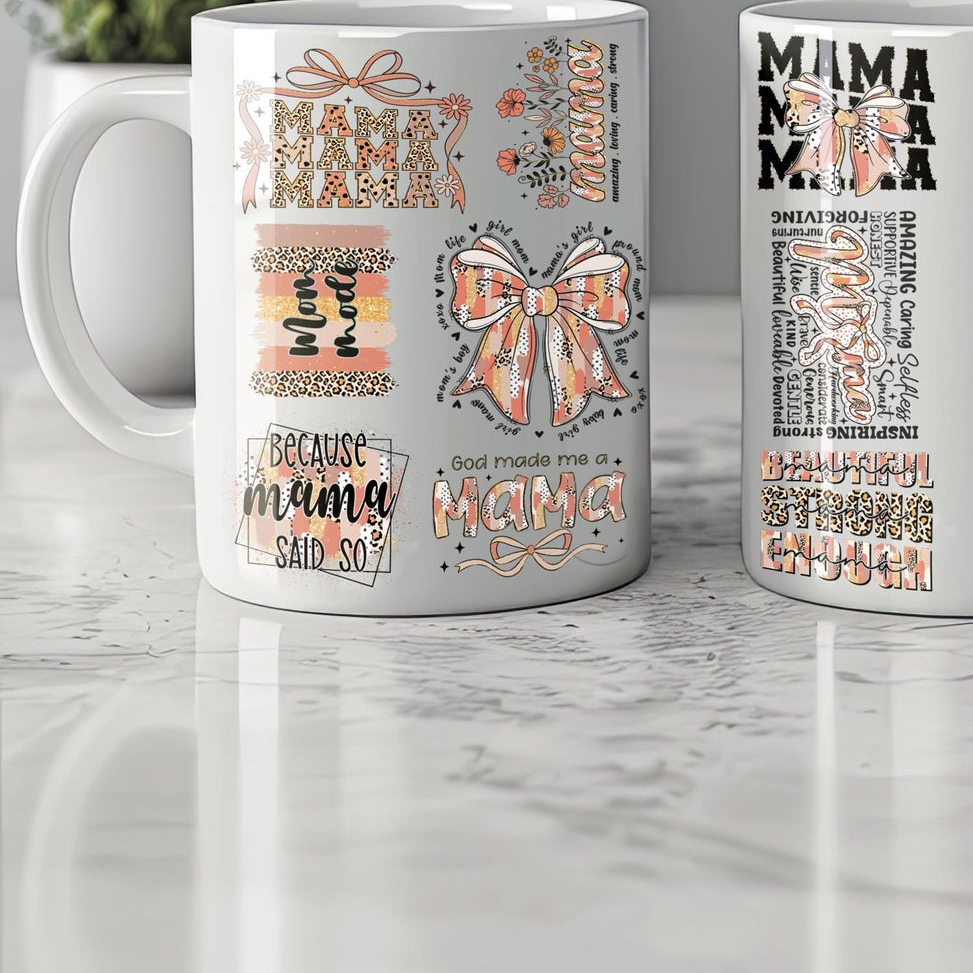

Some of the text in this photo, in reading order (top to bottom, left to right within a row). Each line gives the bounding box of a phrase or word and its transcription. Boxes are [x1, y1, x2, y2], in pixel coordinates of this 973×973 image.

[756, 30, 935, 104] MAMA
[268, 99, 441, 141] MAMA
[565, 40, 607, 201] mama
[608, 43, 622, 201] amazing loving caring strong
[268, 132, 439, 173] MAMA
[269, 169, 441, 208] MAMA
[770, 240, 788, 305] Beautiful
[898, 210, 917, 294] AMAZING
[282, 256, 329, 356] Mom
[323, 256, 361, 358] mode
[451, 452, 607, 471] God made me a
[825, 425, 919, 441] INSPIRING
[762, 449, 934, 489] BEAUTIFUL
[242, 478, 397, 525] mama
[760, 484, 934, 544] STRONG
[273, 535, 369, 572] SAID SO
[762, 532, 933, 592] ENOUGH
